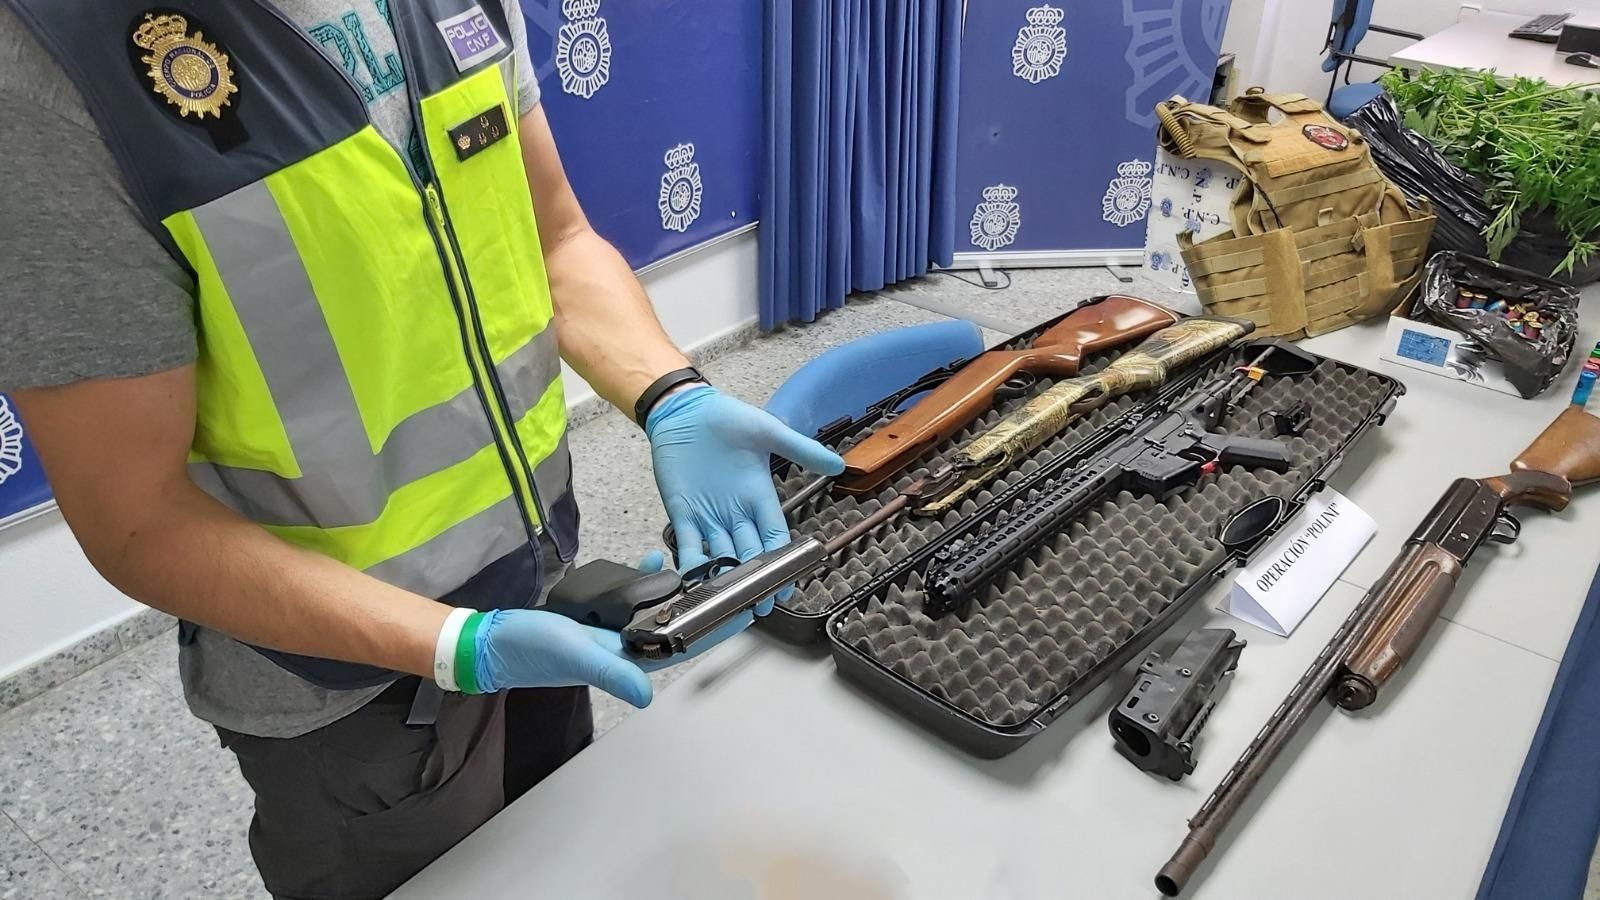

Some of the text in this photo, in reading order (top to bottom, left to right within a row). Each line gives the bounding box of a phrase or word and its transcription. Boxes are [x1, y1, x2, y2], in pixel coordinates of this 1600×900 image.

[466, 32, 491, 53] CNP
[1182, 207, 1220, 225] C.N.P.
[1256, 536, 1310, 592] OPERACIÓN
